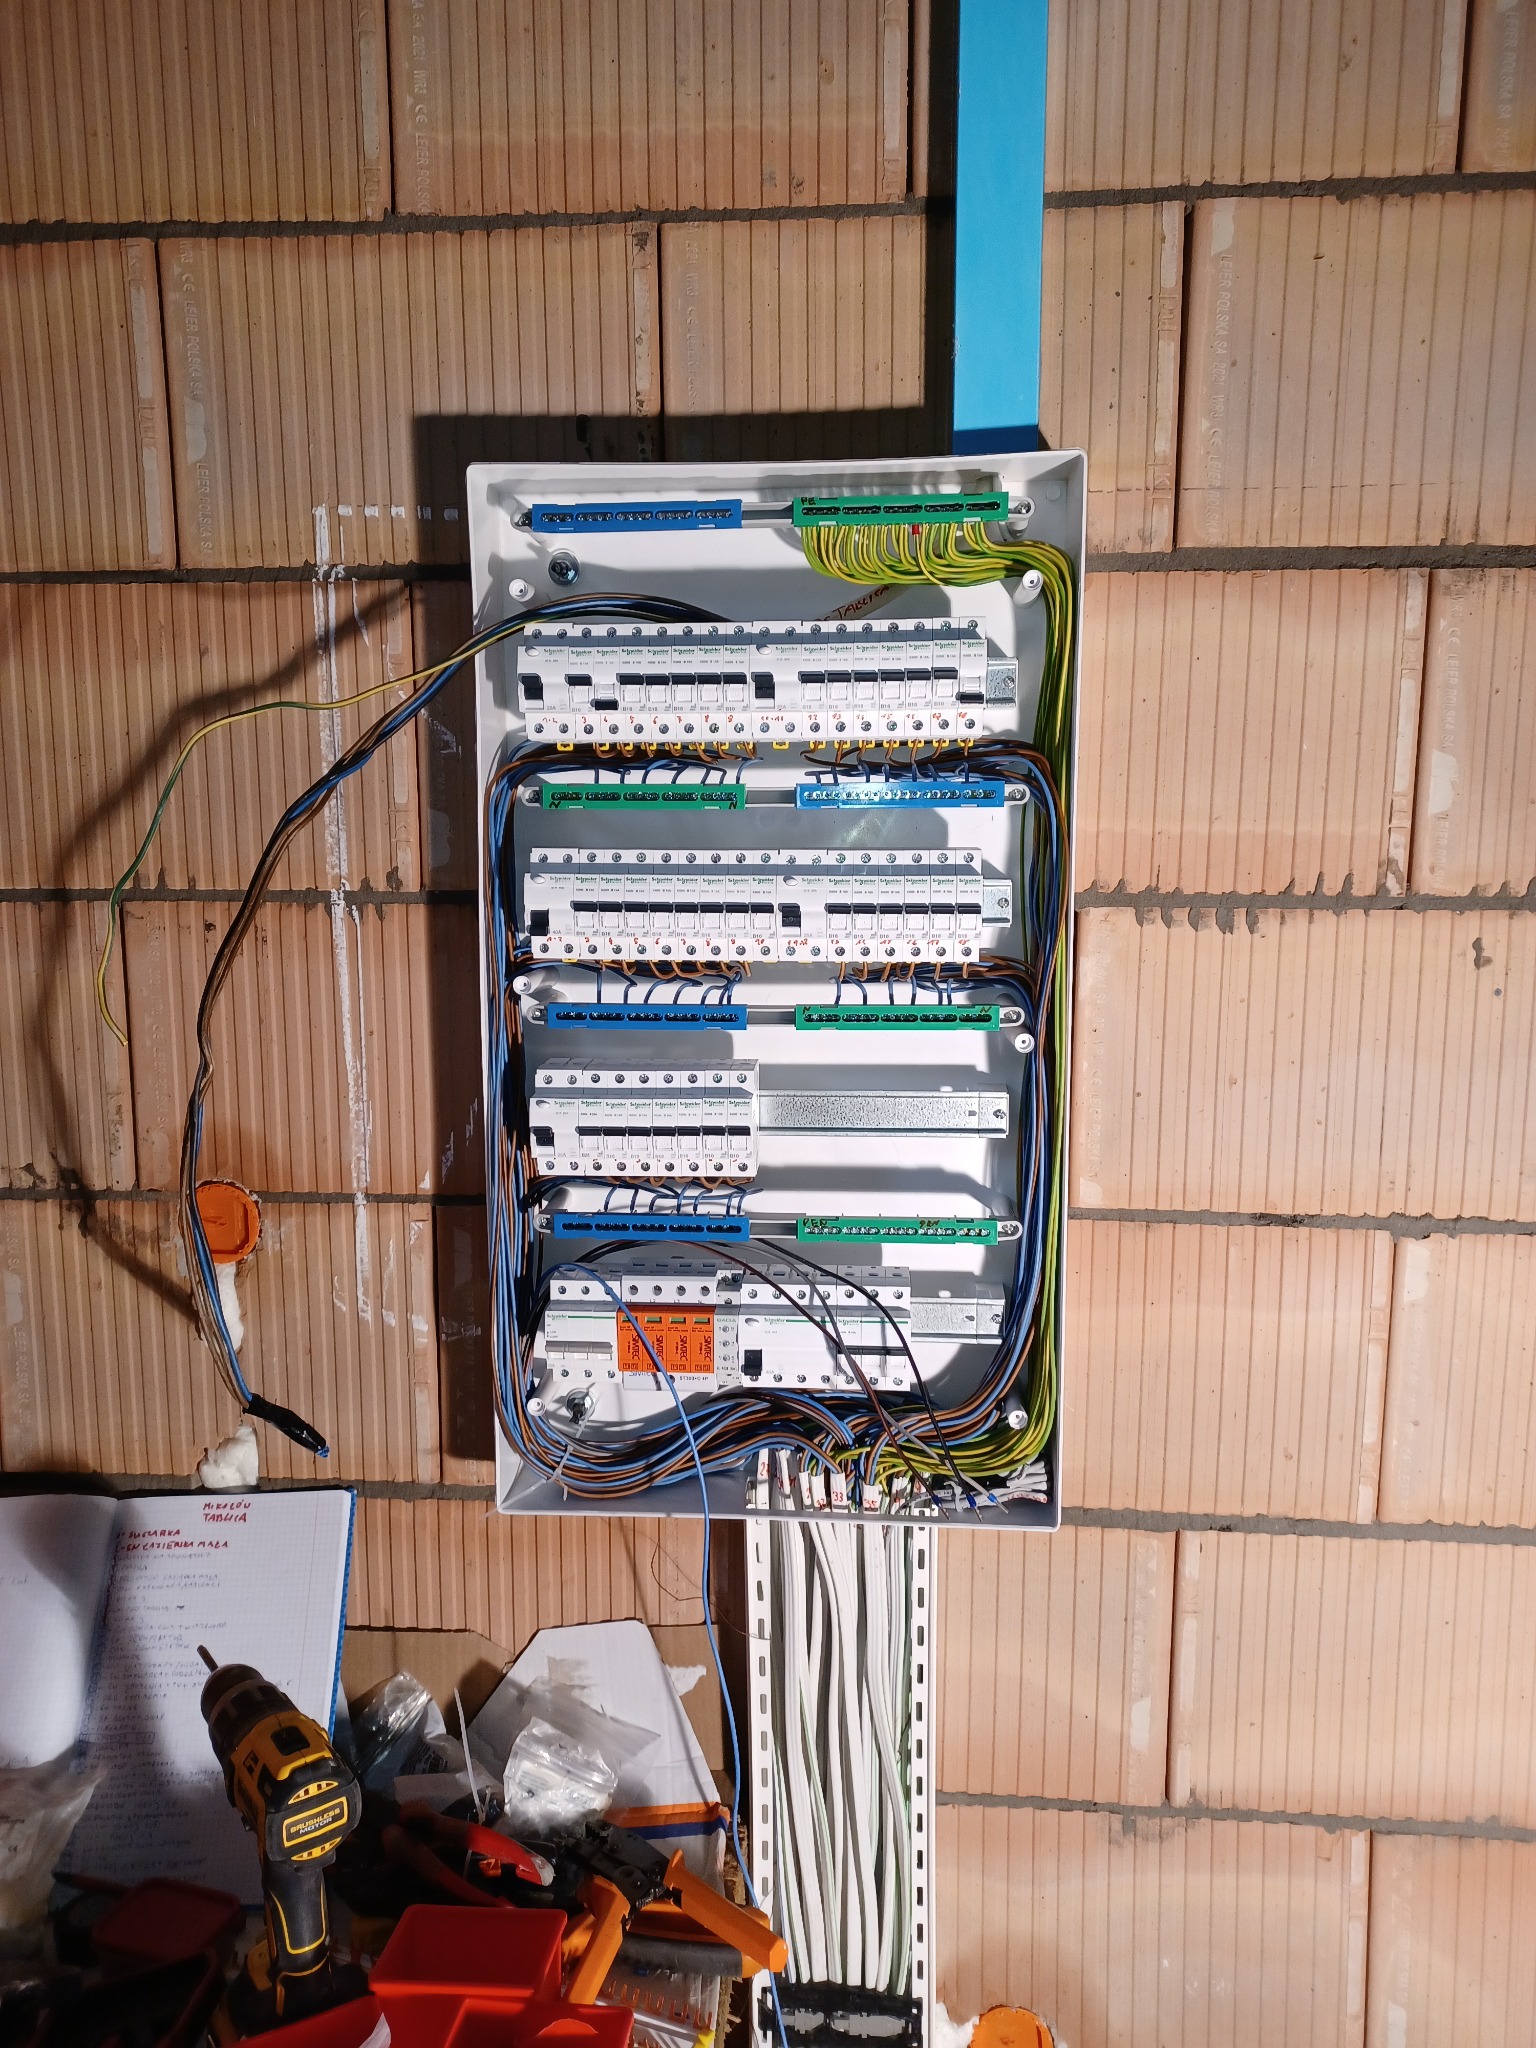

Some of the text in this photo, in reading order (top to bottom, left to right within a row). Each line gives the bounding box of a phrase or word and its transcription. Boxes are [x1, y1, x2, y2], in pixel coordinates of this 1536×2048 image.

[1504, 13, 1520, 47] LEIER
[1500, 52, 1518, 99] POLSKA
[415, 132, 430, 166] LEIER
[416, 169, 431, 213] POLSKA
[1218, 254, 1233, 288] LEIER
[185, 301, 200, 332] LEIER
[1215, 291, 1232, 337] POLSKA
[188, 336, 203, 378] POLSKA
[1213, 340, 1229, 356] SA
[1212, 361, 1227, 387] 2021
[196, 463, 211, 494] LEIER
[1207, 455, 1222, 488] LEIER
[801, 496, 816, 505] PE
[1205, 490, 1220, 533] POLSKA
[198, 497, 212, 538] POLSKA
[1445, 653, 1460, 686] LEIER
[1442, 688, 1458, 730] POLSKA
[1434, 814, 1449, 847] LEIER
[802, 1218, 828, 1228] PEN
[680, 1335, 688, 1361] SIMTEC
[704, 1335, 712, 1361] SIMTEC
[832, 1491, 844, 1502] 33
[203, 1513, 248, 1523] TABLICA
[198, 1540, 228, 1550] MAŁA
[290, 1807, 340, 1834] BRUSHLESS
[299, 1816, 332, 1835] MOTOR
